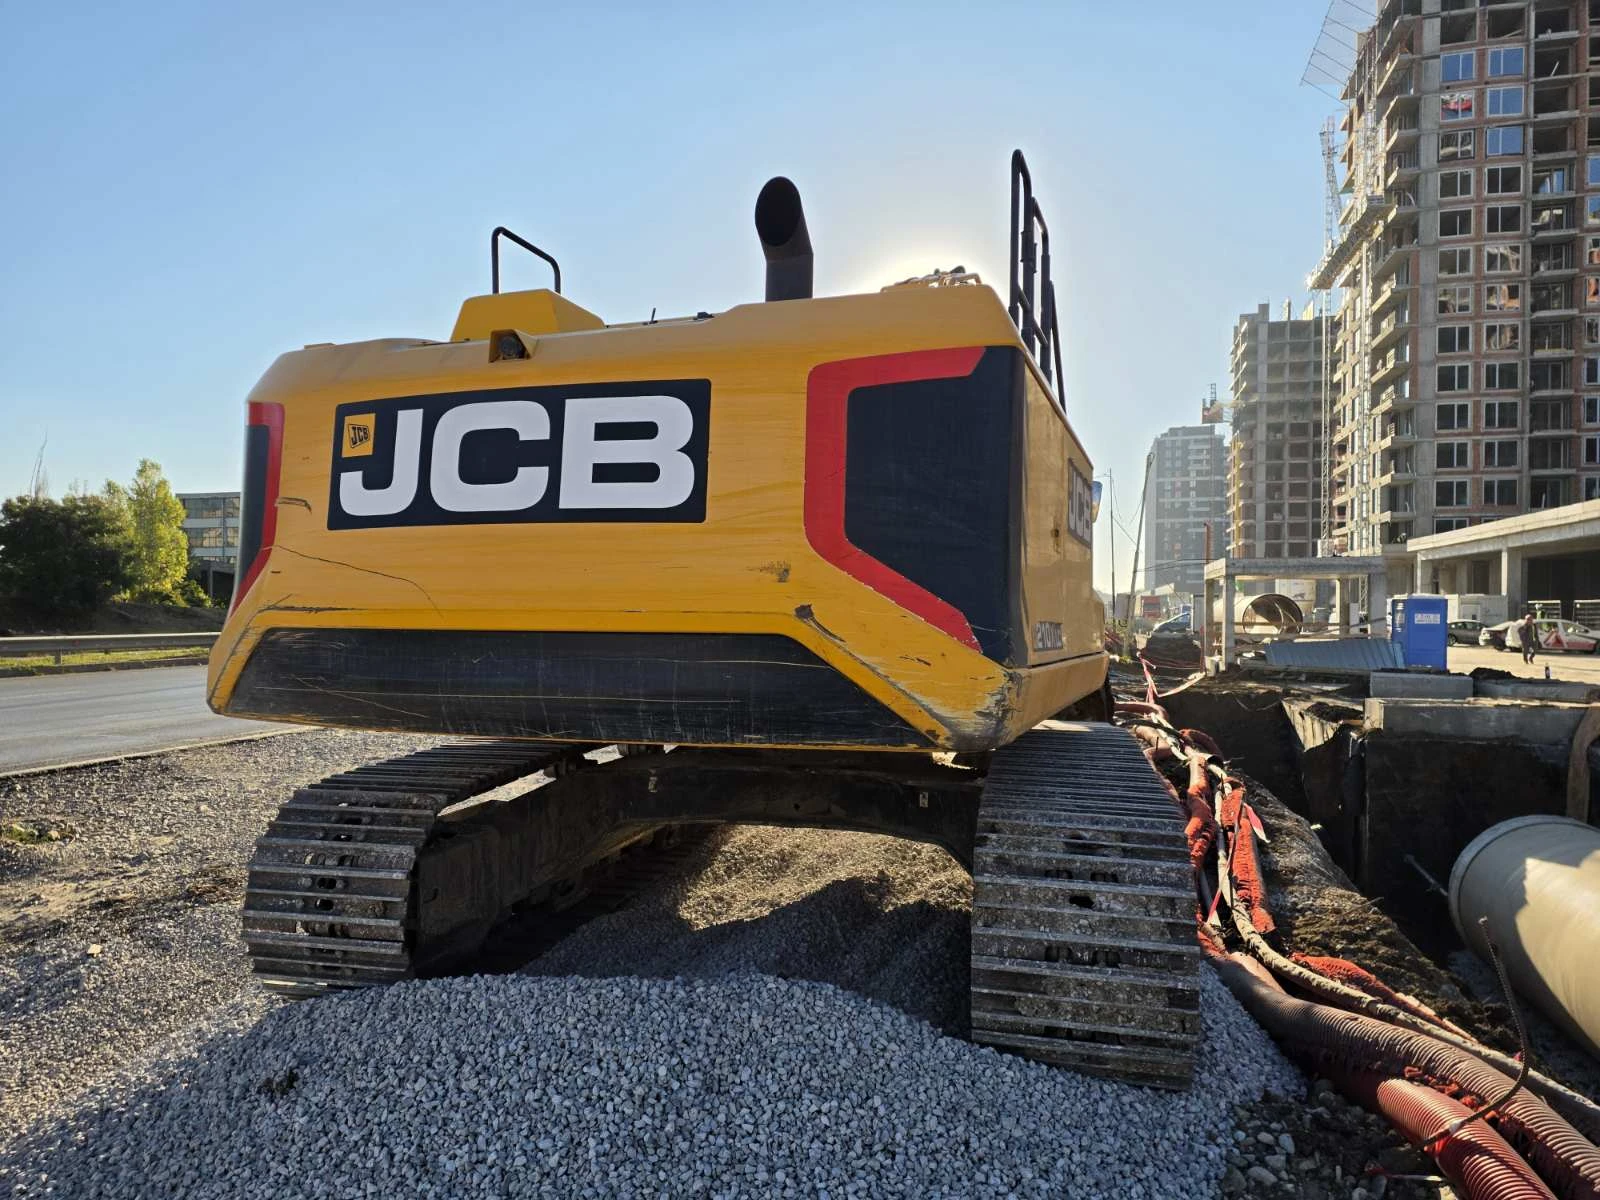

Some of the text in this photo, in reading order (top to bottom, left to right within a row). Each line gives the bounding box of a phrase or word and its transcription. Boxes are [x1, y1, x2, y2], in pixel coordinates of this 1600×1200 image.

[340, 395, 695, 516] JCB
[351, 426, 369, 445] JCB
[1069, 470, 1091, 543] JCB
